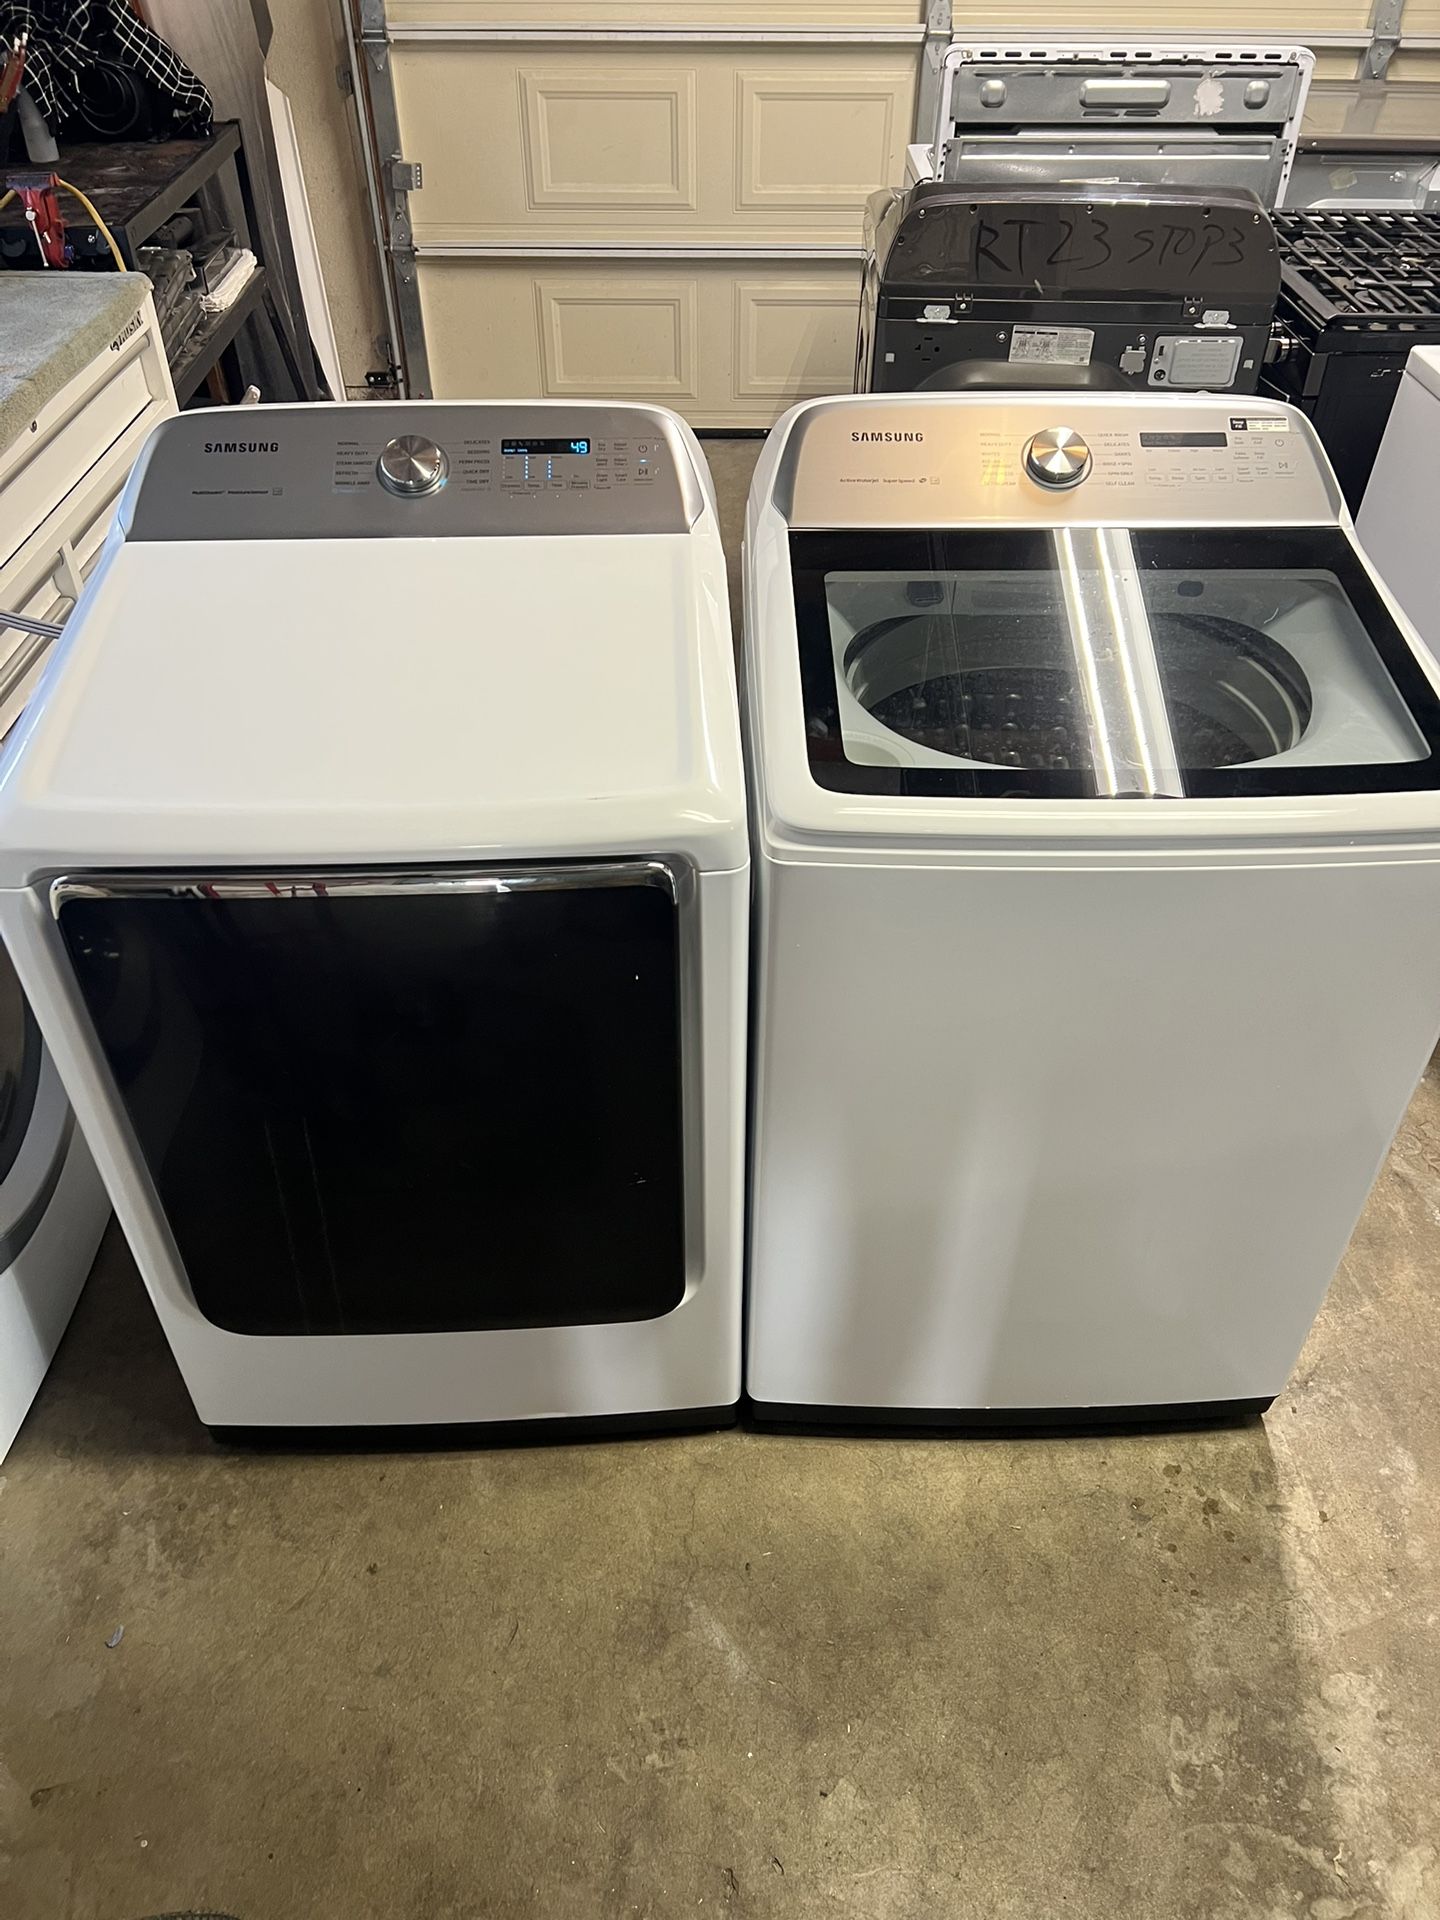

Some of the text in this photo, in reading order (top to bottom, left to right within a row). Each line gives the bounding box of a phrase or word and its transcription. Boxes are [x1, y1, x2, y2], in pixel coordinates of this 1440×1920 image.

[851, 431, 924, 443] SAMSUNG
[204, 441, 280, 454] SAMSUNG
[570, 440, 588, 454] 49
